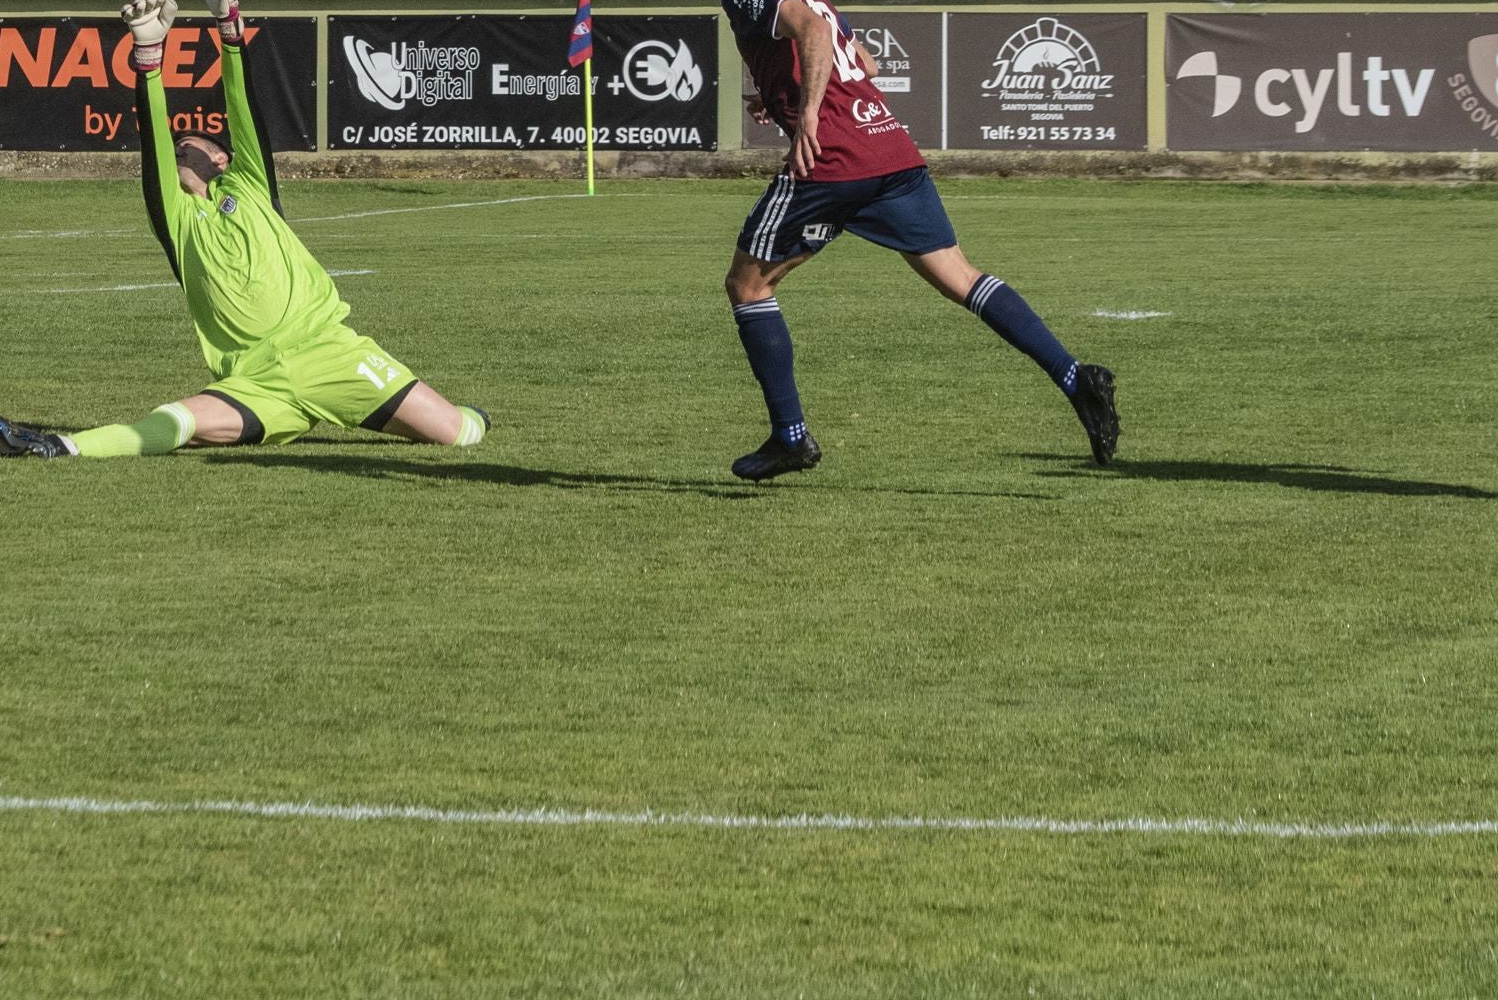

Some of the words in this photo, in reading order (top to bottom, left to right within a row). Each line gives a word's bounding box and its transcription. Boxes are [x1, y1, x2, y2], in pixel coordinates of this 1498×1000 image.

[390, 40, 480, 71] Universo
[886, 60, 910, 74] spa
[398, 69, 473, 106] Digital
[491, 63, 580, 100] Energía
[981, 59, 1046, 89] Juan
[1051, 60, 1115, 89] Sanz
[1001, 103, 1027, 111] SANTO
[1027, 102, 1049, 111] TOMÉ
[1049, 103, 1064, 111] DEL
[1064, 103, 1094, 111] PUERTO
[1254, 52, 1436, 133] cyltv
[85, 104, 123, 141] by
[1031, 113, 1064, 121] SEGOVIA
[342, 126, 363, 144] C/
[368, 122, 418, 144] JOSÉ
[422, 126, 522, 146] ZORRILLA,
[527, 126, 545, 143] 7.
[615, 127, 702, 145] SEGOVIA
[980, 125, 1015, 140] Telf:
[1017, 126, 1046, 140] 921
[1050, 126, 1070, 140] 55
[1072, 126, 1093, 140] 73
[1095, 126, 1116, 140] 34
